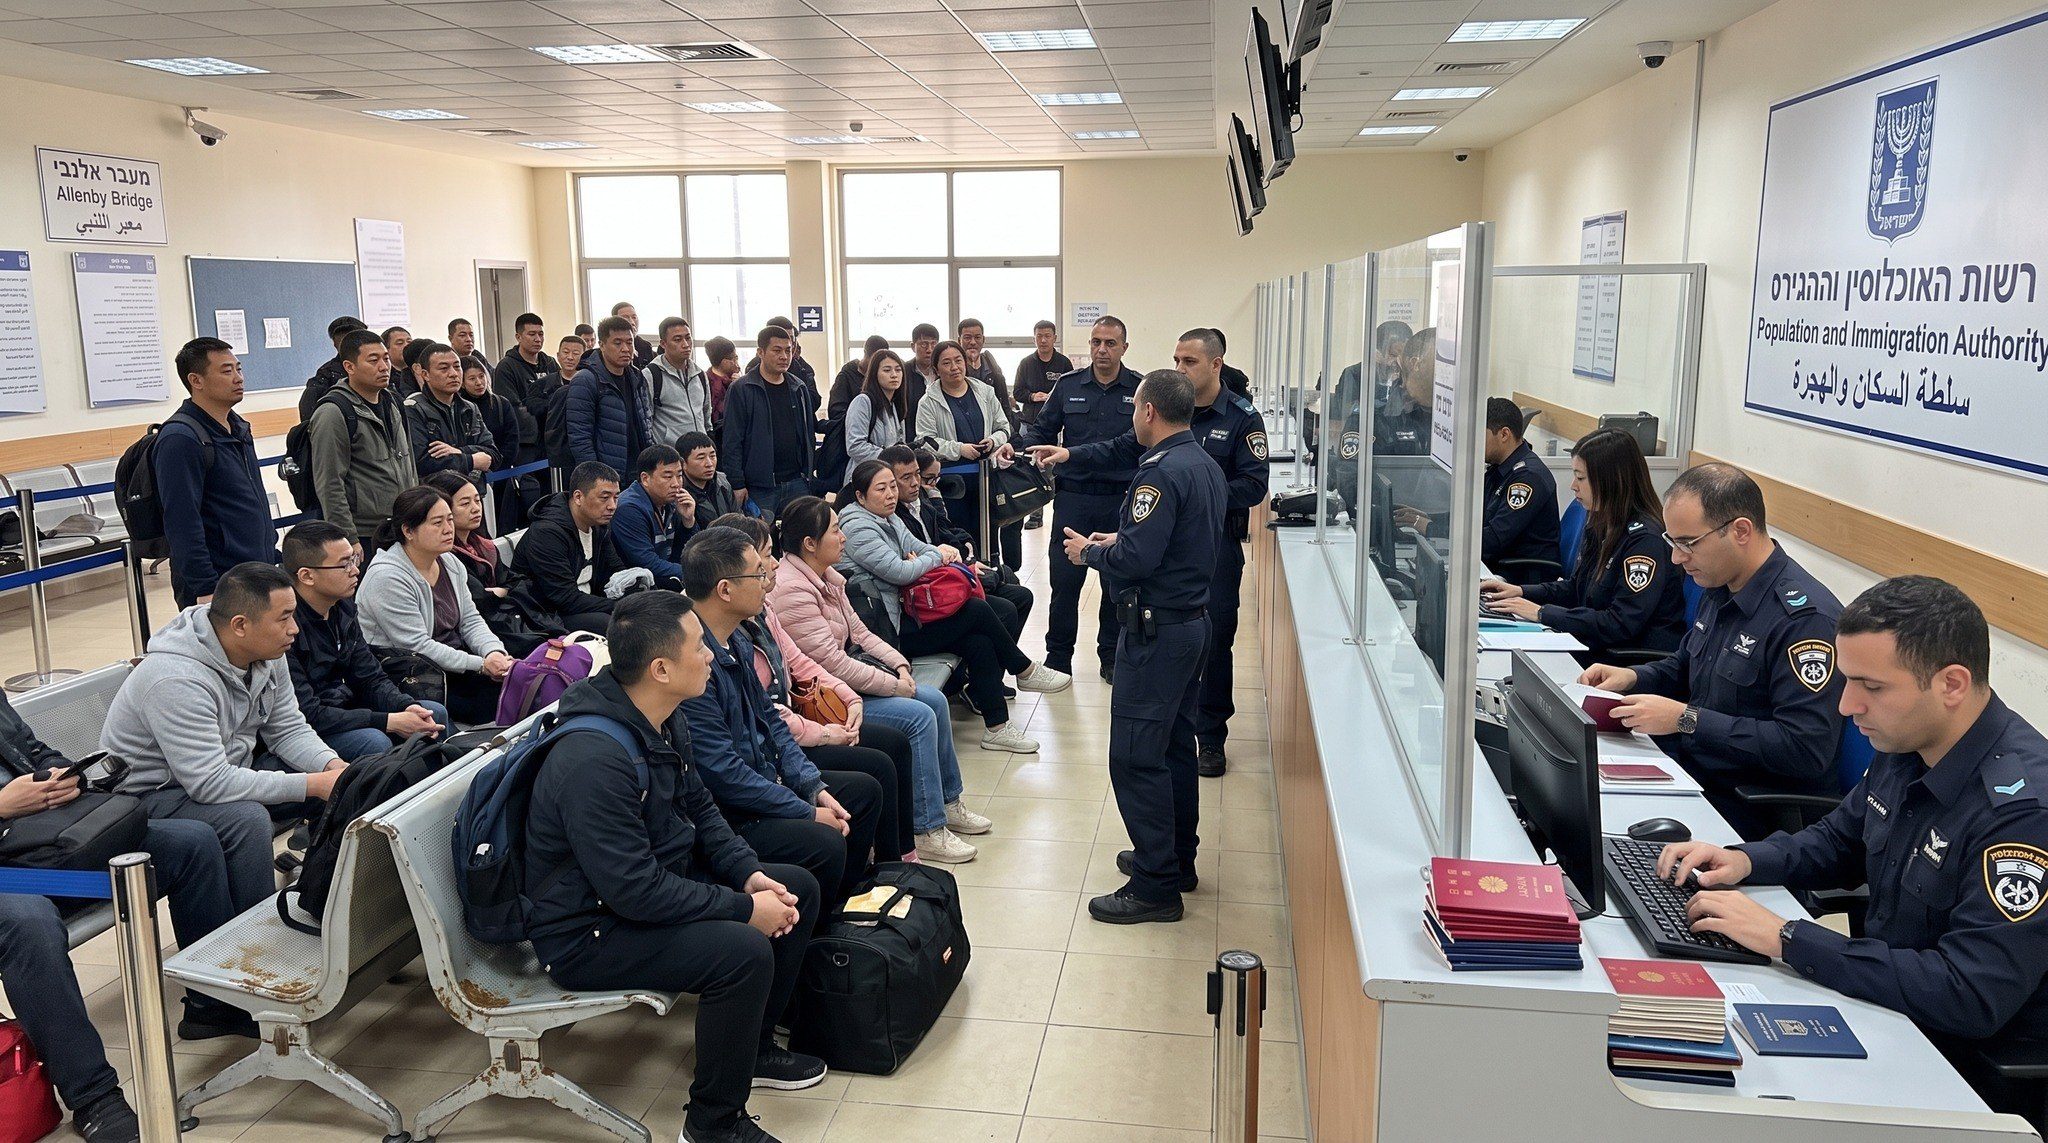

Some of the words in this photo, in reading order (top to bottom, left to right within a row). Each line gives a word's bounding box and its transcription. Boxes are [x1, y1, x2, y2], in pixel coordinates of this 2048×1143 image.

[53, 158, 102, 181] אלנבי
[106, 166, 151, 186] מעבר
[56, 185, 107, 209] Allenby
[111, 190, 153, 212] Bridge
[76, 212, 111, 236] اللنبي
[115, 220, 143, 235] معبر
[1771, 270, 1840, 301] וההגירס
[1844, 257, 1952, 311] האוכלוסין
[1959, 262, 2037, 304] רשות
[1757, 316, 1819, 347] Population
[1822, 320, 1848, 347] and
[1851, 320, 1949, 358] Immigration
[1952, 324, 2048, 372] Authority
[1792, 358, 1848, 406] والهجرة
[1852, 368, 1910, 409] السكان
[1915, 366, 1971, 416] سلطة
